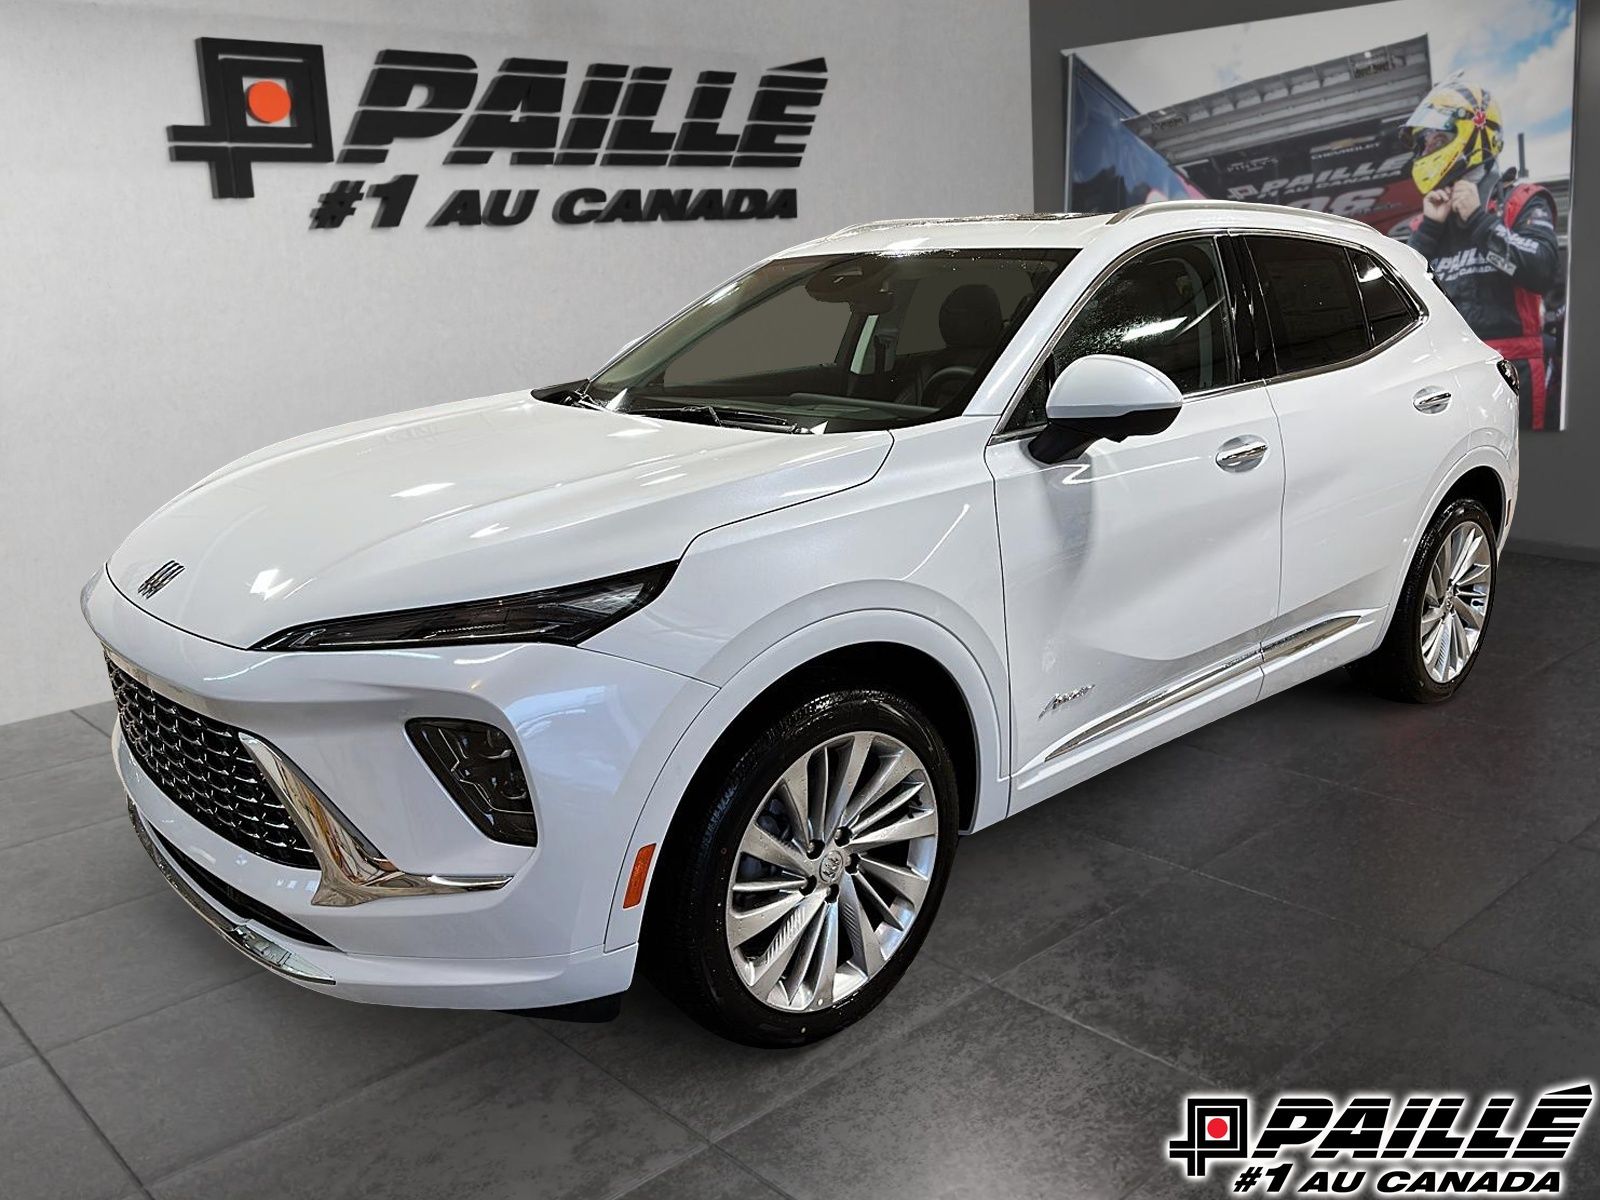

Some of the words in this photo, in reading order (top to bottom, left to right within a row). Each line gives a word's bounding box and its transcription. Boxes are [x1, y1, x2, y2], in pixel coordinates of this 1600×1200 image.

[337, 49, 828, 168] PAILLÉ
[309, 175, 418, 229] #1
[428, 190, 540, 227] AU
[552, 188, 798, 224] CANADA
